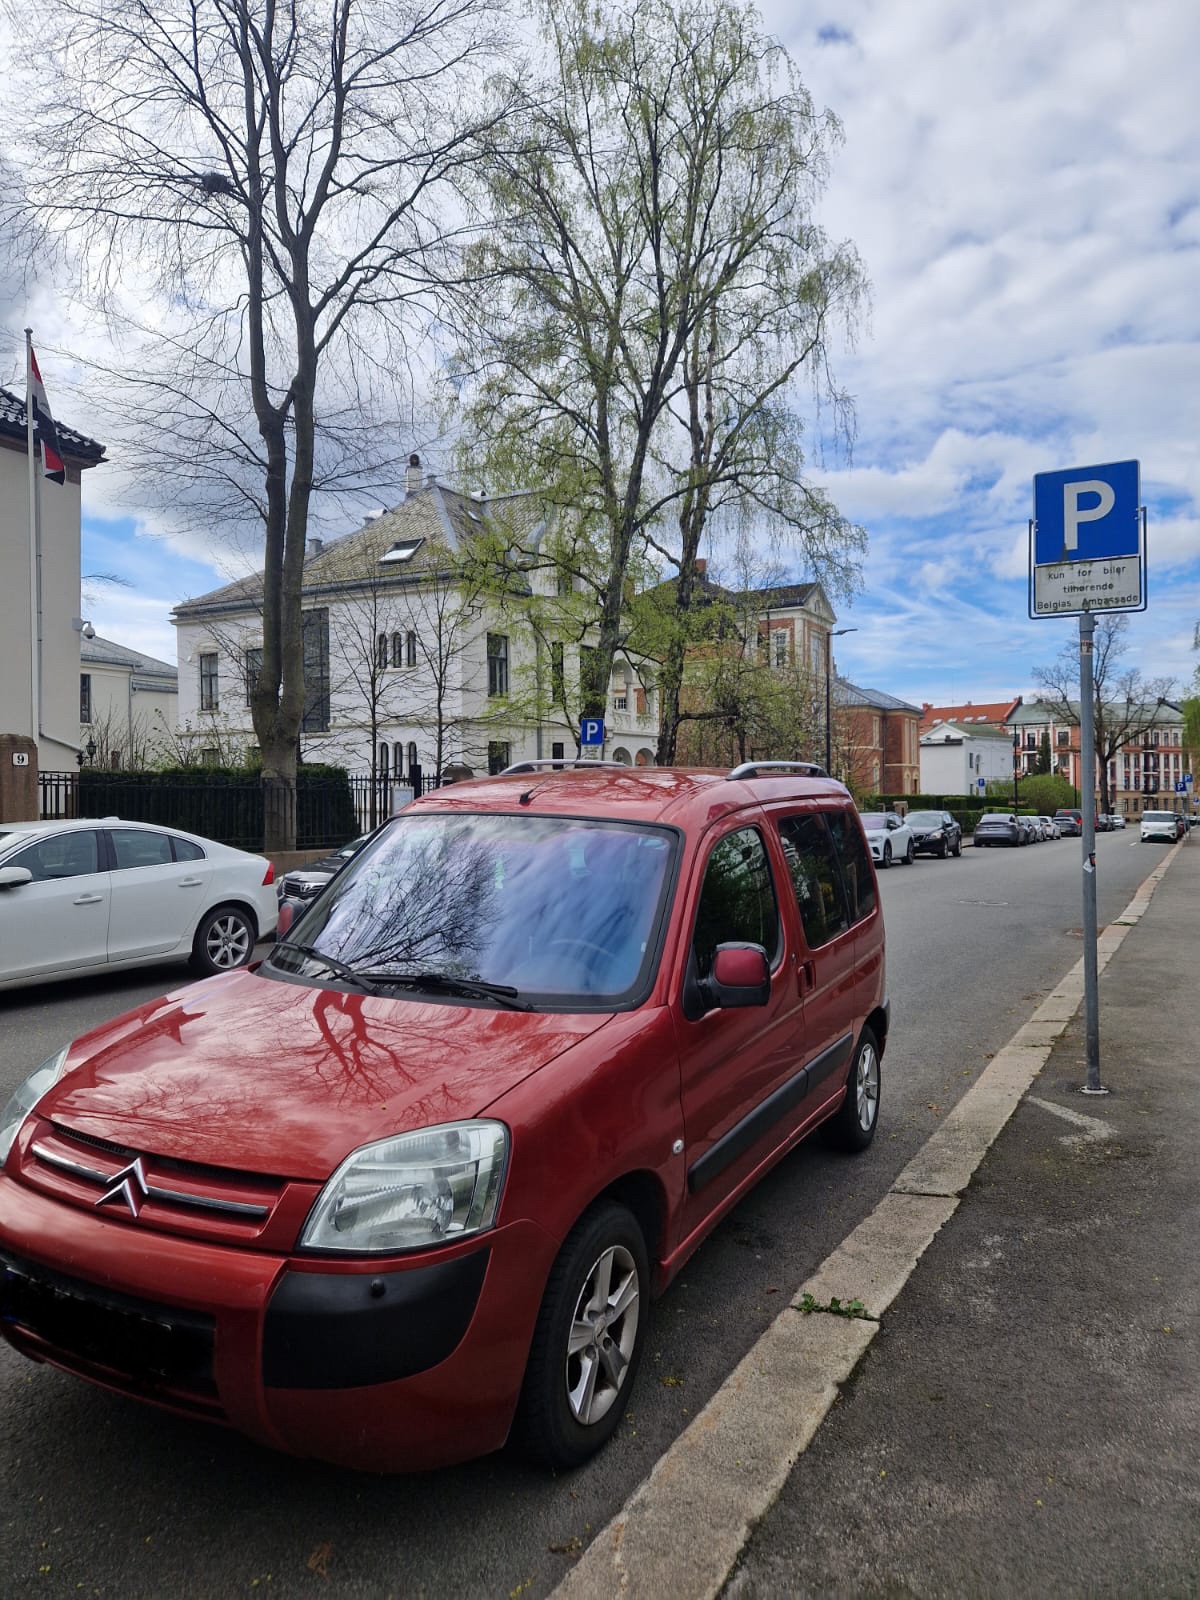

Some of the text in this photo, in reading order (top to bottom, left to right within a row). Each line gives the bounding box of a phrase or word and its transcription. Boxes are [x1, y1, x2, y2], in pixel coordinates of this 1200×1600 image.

[1063, 479, 1115, 551] P
[586, 721, 598, 741] P
[17, 754, 25, 764] 9
